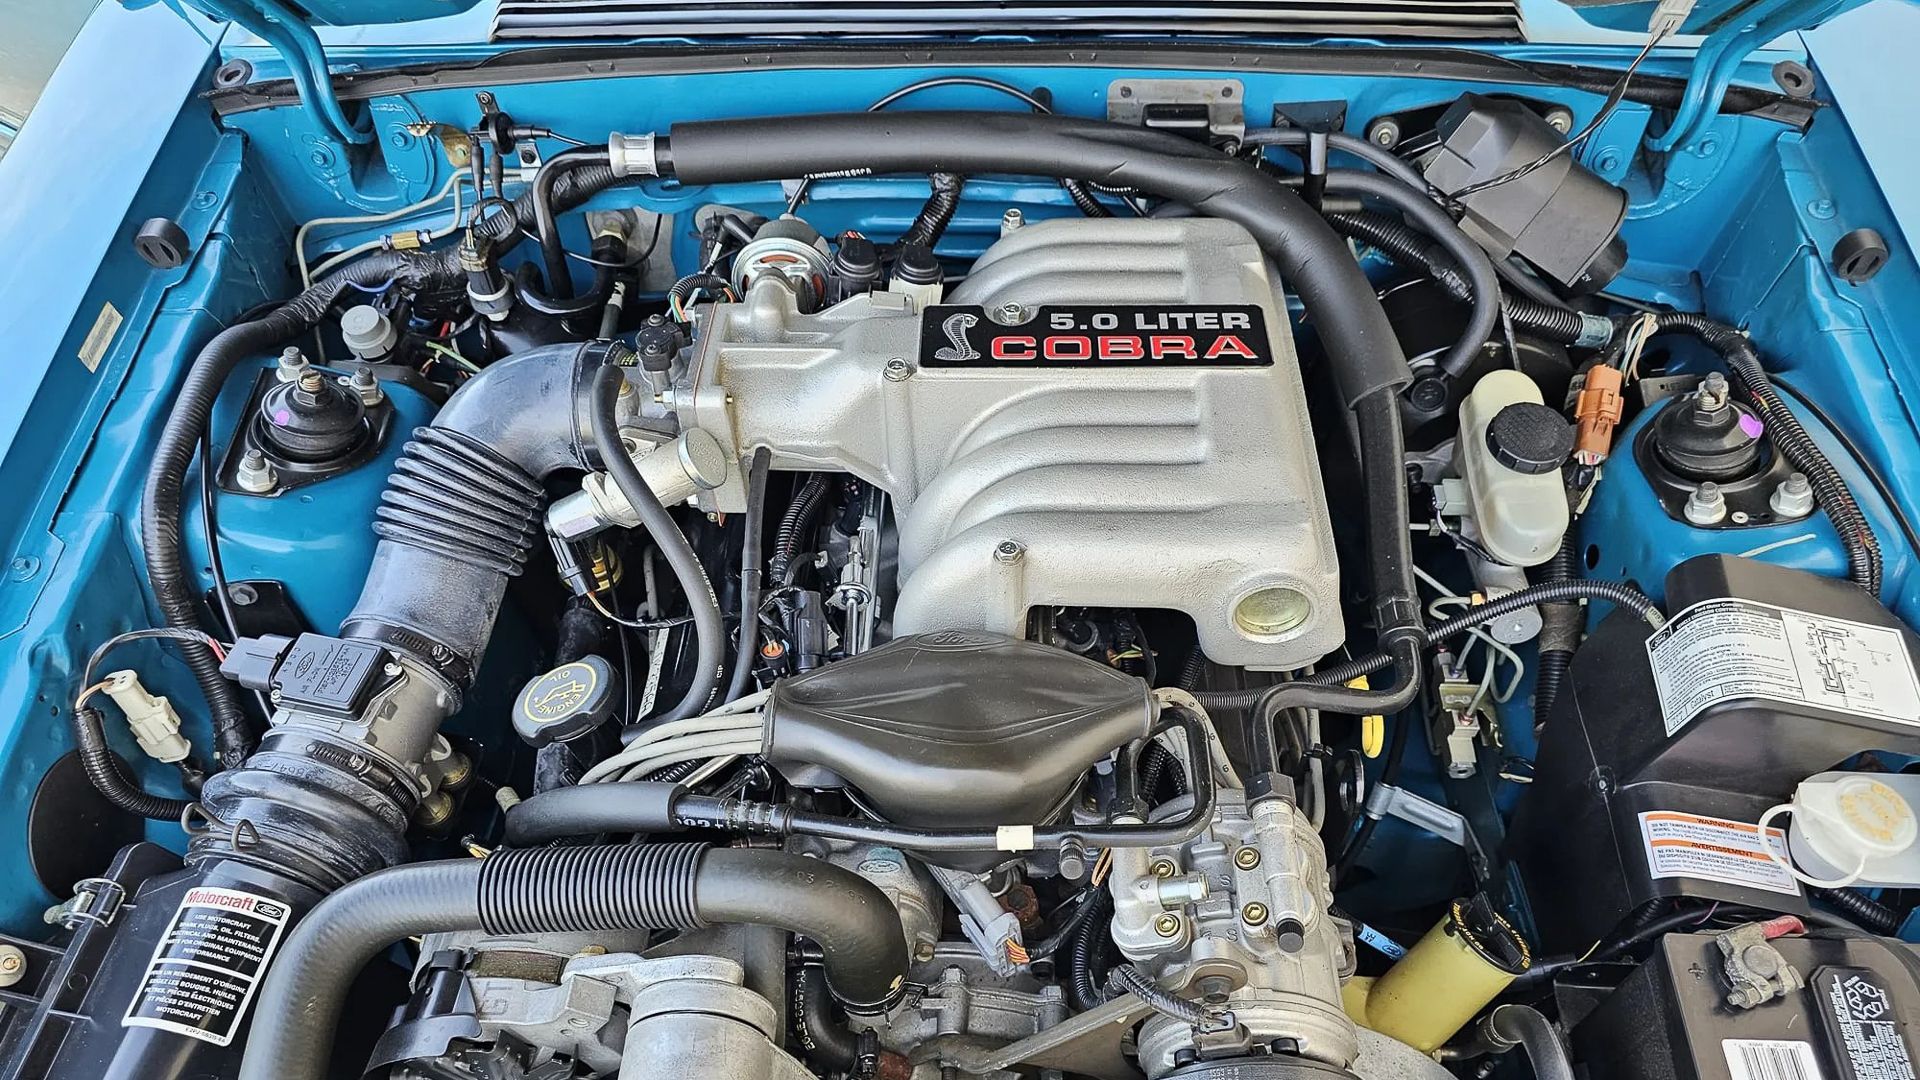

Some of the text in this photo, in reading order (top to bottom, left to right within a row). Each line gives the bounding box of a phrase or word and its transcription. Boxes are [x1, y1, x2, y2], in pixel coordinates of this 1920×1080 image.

[1050, 312, 1251, 331] 5.0 LITER
[990, 335, 1259, 361] COBRA
[549, 671, 571, 682] OIL
[539, 693, 582, 714] ENGINE
[1691, 690, 1714, 709] Catalyst
[1696, 818, 1735, 829] WARNING
[1691, 842, 1753, 857] AVERTISSEMENT
[186, 891, 253, 910] Motorcraft
[208, 914, 251, 929] MOTORCRAFT
[193, 940, 224, 951] ORIGINAL
[224, 946, 262, 962] EQUIPMENT
[217, 935, 264, 954] MAINTENANCE
[183, 948, 230, 962] PERFORMANCE
[173, 971, 213, 983] RENDEMENT
[177, 1000, 221, 1016] D'ENTRETIEN
[191, 991, 234, 1010] ÉLECTRIQUES
[156, 1006, 202, 1020] MOTORCRAFT
